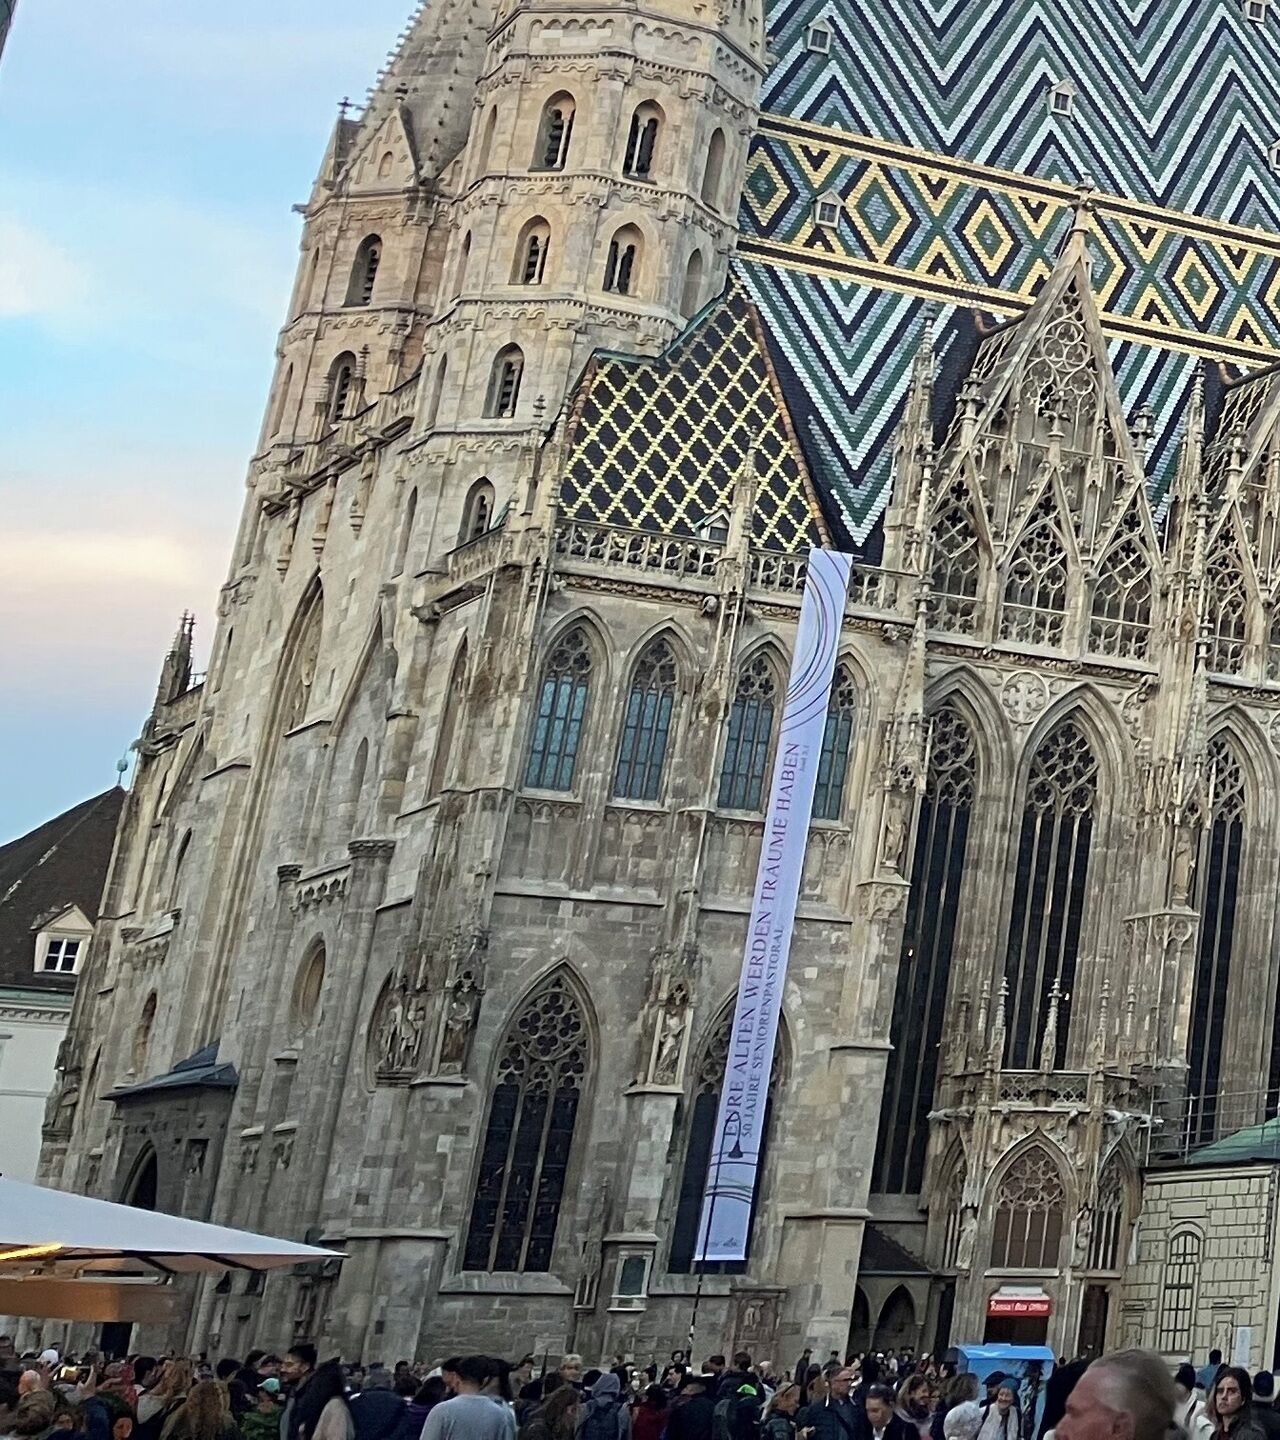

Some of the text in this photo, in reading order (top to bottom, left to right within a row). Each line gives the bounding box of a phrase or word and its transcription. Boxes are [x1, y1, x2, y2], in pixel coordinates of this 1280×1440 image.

[775, 742, 801, 812] HABEN
[760, 817, 788, 905] TRÄUME
[743, 911, 772, 1000] WERDEN
[752, 925, 785, 1070] SENIORENPASTORAL
[733, 1008, 756, 1075] ALTEN
[744, 1075, 761, 1120] JAHRE
